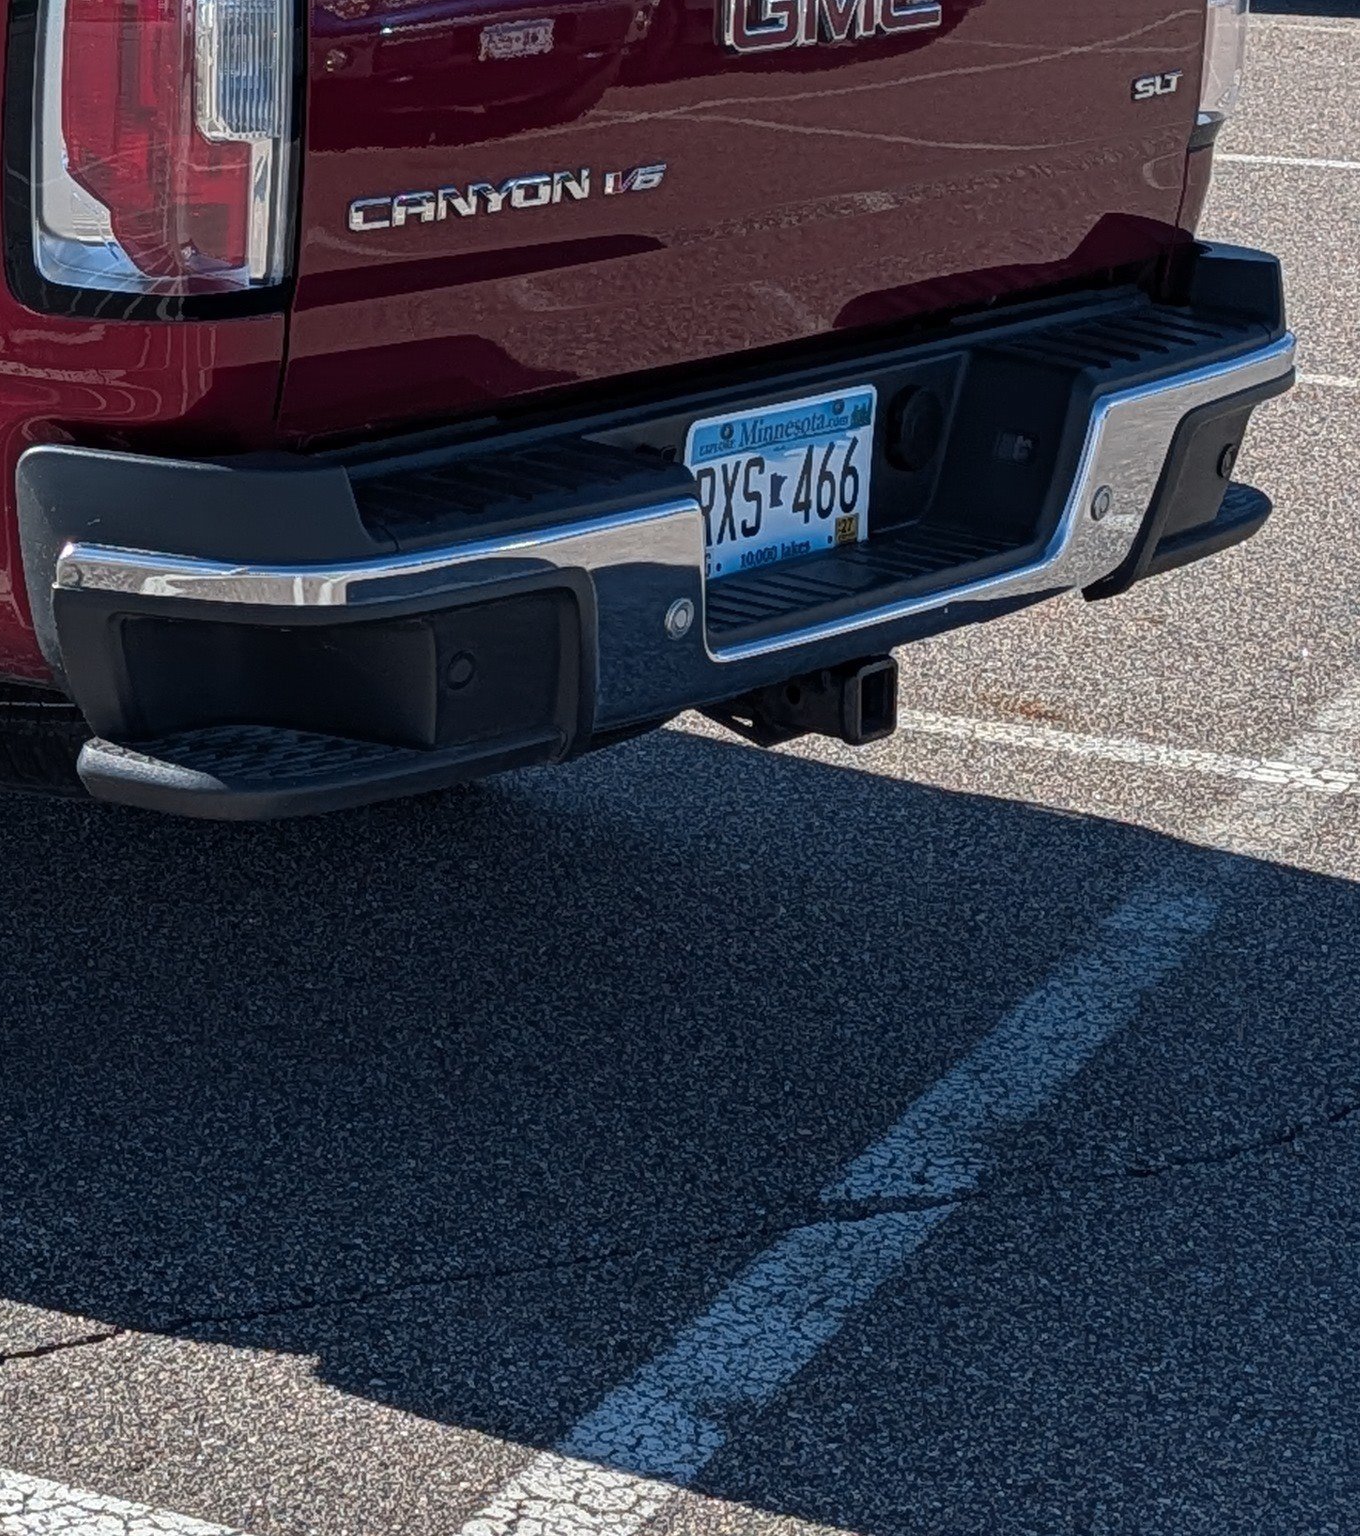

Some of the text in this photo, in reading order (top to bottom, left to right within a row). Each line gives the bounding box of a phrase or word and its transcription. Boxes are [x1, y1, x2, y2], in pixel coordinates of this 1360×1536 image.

[1132, 69, 1183, 100] SLT
[348, 163, 668, 232] CANYON V6
[696, 436, 859, 547] RXS 466
